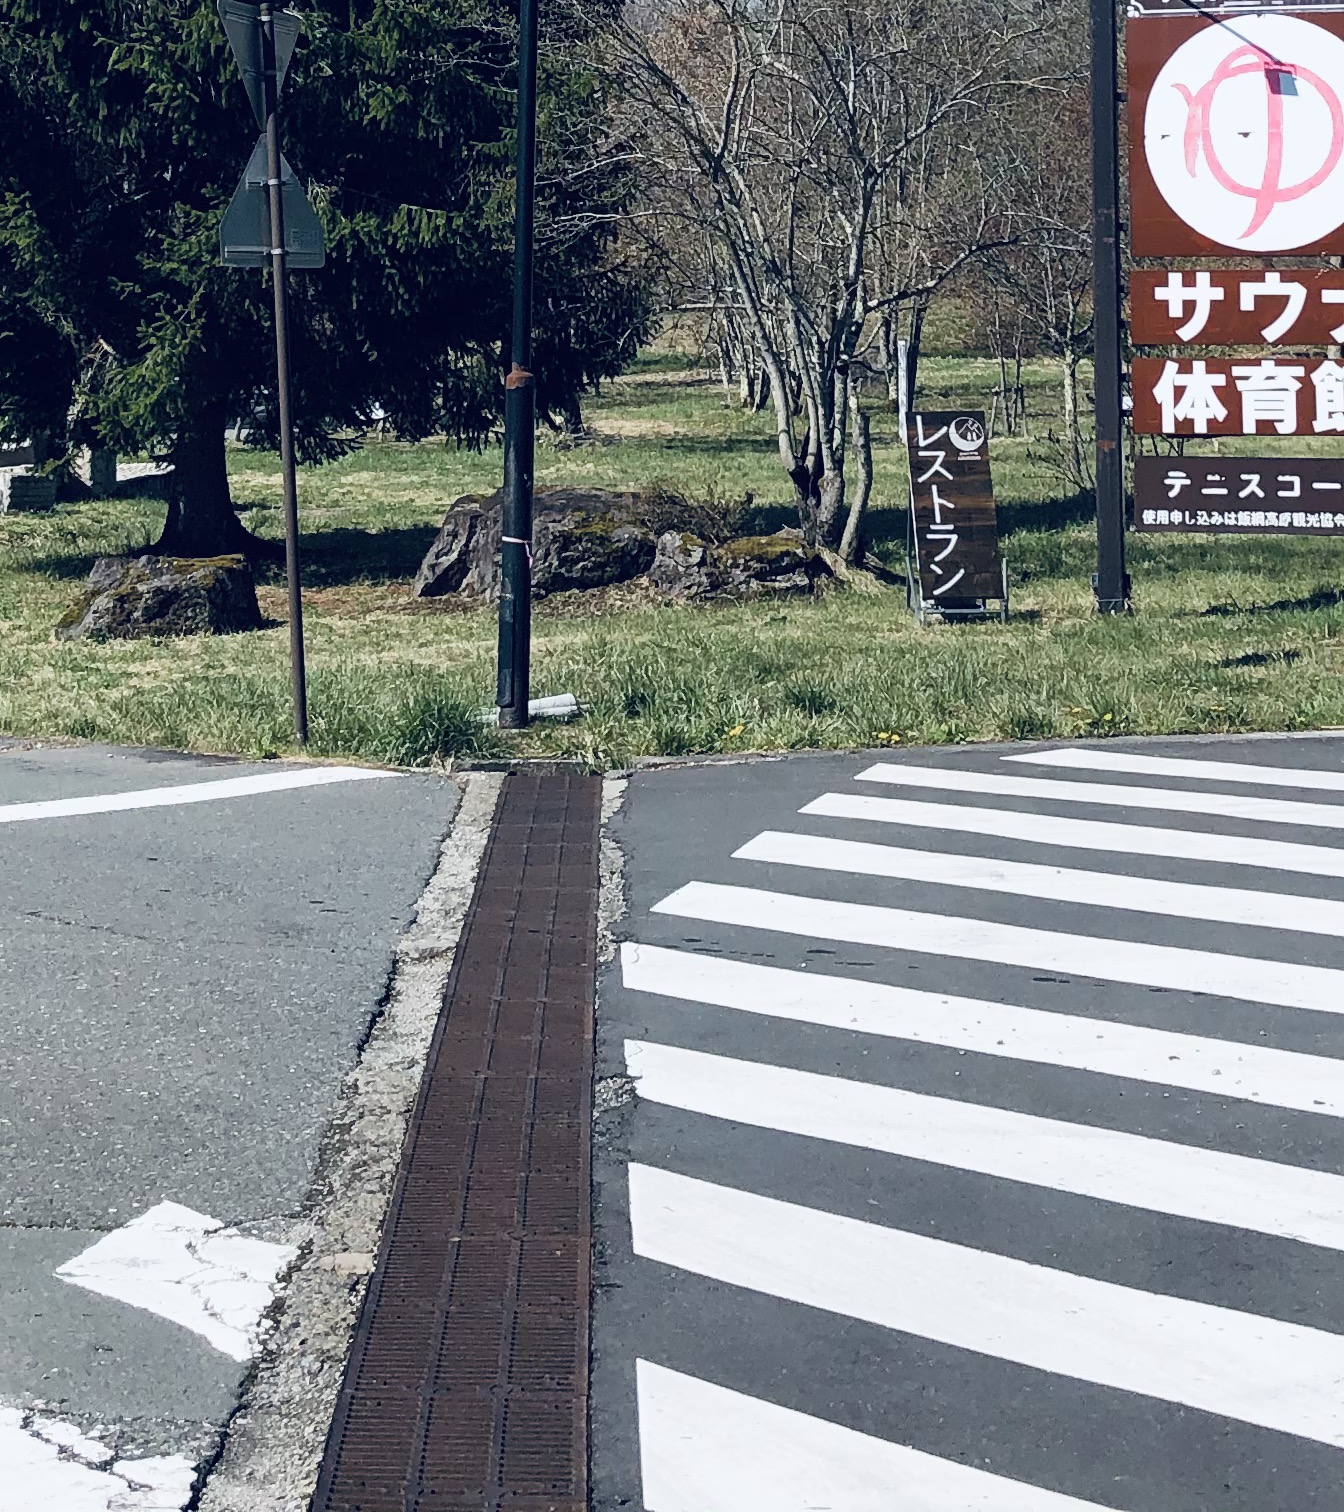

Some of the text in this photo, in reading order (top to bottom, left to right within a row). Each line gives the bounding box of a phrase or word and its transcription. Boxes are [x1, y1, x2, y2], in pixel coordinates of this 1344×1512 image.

[1171, 44, 1344, 239] ゆ
[915, 415, 966, 596] レストラン
